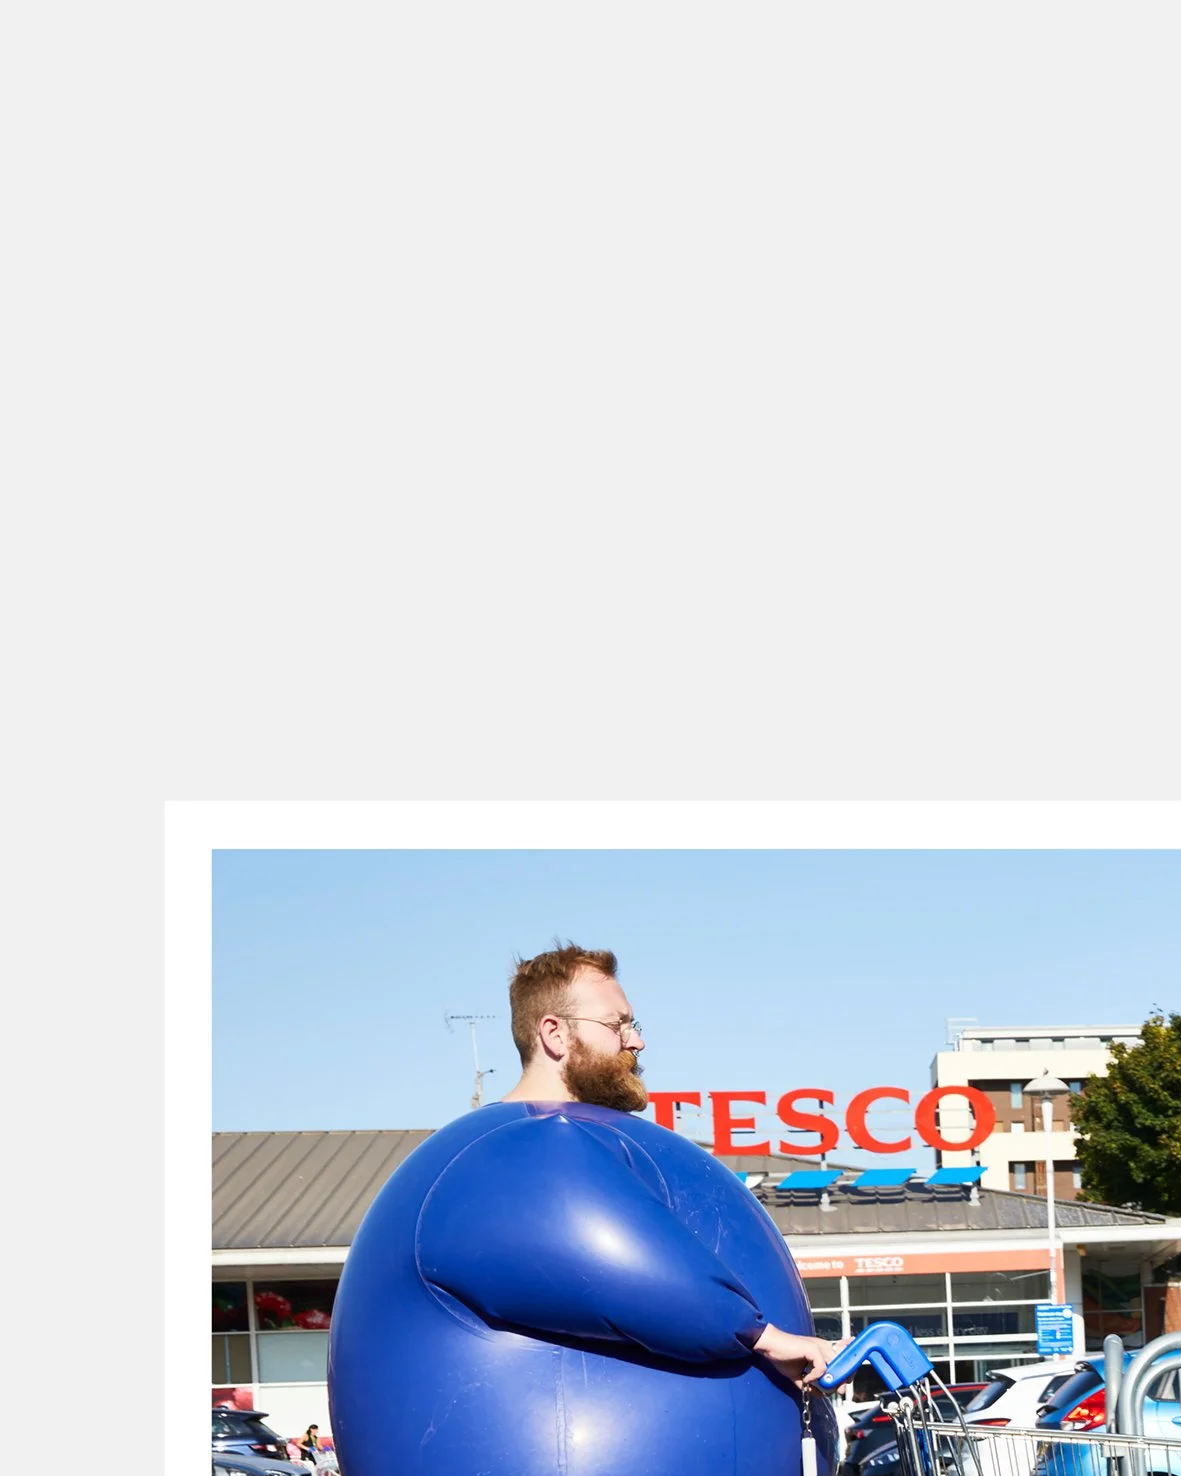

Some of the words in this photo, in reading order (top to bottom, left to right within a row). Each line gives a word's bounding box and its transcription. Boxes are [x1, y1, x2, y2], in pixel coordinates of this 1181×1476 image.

[647, 1085, 996, 1157] TESCO
[796, 1260, 831, 1271] lcome
[854, 1257, 904, 1269] TESCO
